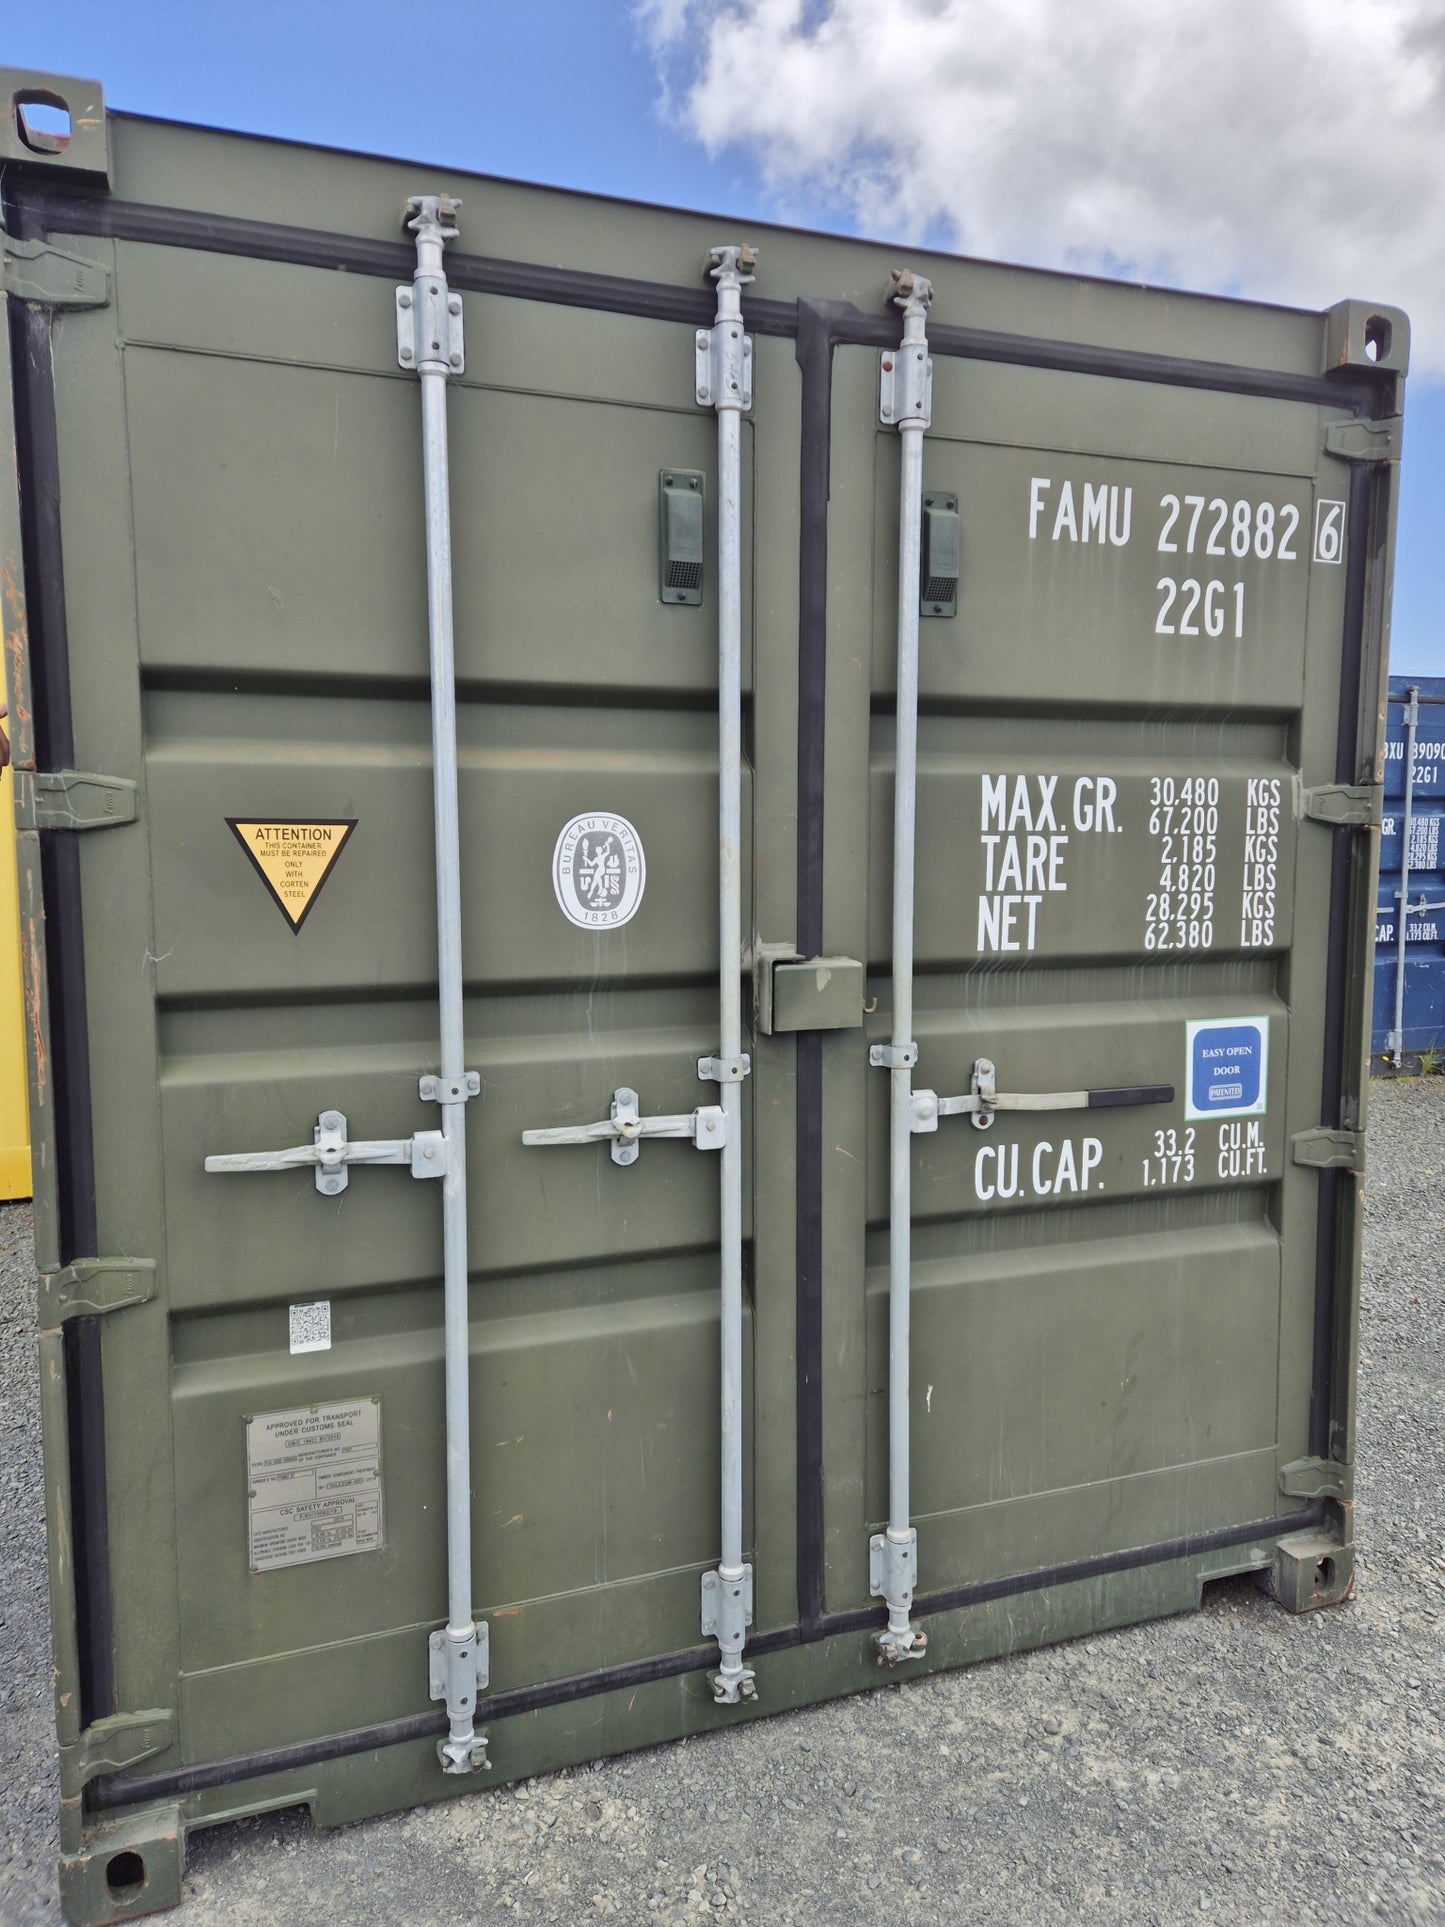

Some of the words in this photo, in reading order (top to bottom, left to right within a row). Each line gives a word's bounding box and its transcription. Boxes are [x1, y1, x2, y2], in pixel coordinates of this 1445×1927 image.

[1028, 477, 1132, 546] FAMU
[1157, 494, 1299, 560] 272882
[1318, 505, 1340, 560] 6
[1154, 577, 1244, 638] 22G1
[1150, 777, 1219, 806] 30,480
[1246, 778, 1281, 806] KGS
[255, 828, 332, 841] ATTENTION
[1149, 806, 1218, 836] 67,200
[1246, 807, 1280, 835] LBS
[562, 820, 596, 875] BUREAU
[602, 820, 638, 874] VERITAS
[980, 835, 1068, 892] TARE
[1161, 835, 1217, 864] 2,185
[1244, 836, 1278, 863] KGS
[1160, 864, 1216, 892] 4,820
[1242, 864, 1277, 891] LBS
[584, 911, 618, 922] 1828
[976, 895, 1042, 952] NET
[1146, 892, 1214, 920] 28,295
[1242, 892, 1276, 919] KGS
[1144, 920, 1213, 950] 62,380
[1240, 919, 1274, 947] LBS
[1202, 1048, 1225, 1058] EASY
[1226, 1046, 1252, 1056] OPEN
[1214, 1066, 1240, 1076] DOOR
[1210, 1086, 1240, 1097] PATENTED
[1154, 1127, 1196, 1158] 33.2
[1218, 1121, 1264, 1151] CU.M.
[1142, 1154, 1195, 1186] 1,173
[1218, 1148, 1268, 1178] CU.FT.
[266, 1419, 303, 1431] APPROVED
[305, 1416, 320, 1425] FOR
[322, 1410, 362, 1422] TRANSPORT
[274, 1426, 298, 1438] UNDER
[301, 1422, 334, 1434] CUSTOMS
[337, 1420, 354, 1428] SEAL
[296, 1503, 321, 1513] SAFETY
[323, 1498, 356, 1508] APPROVAL
